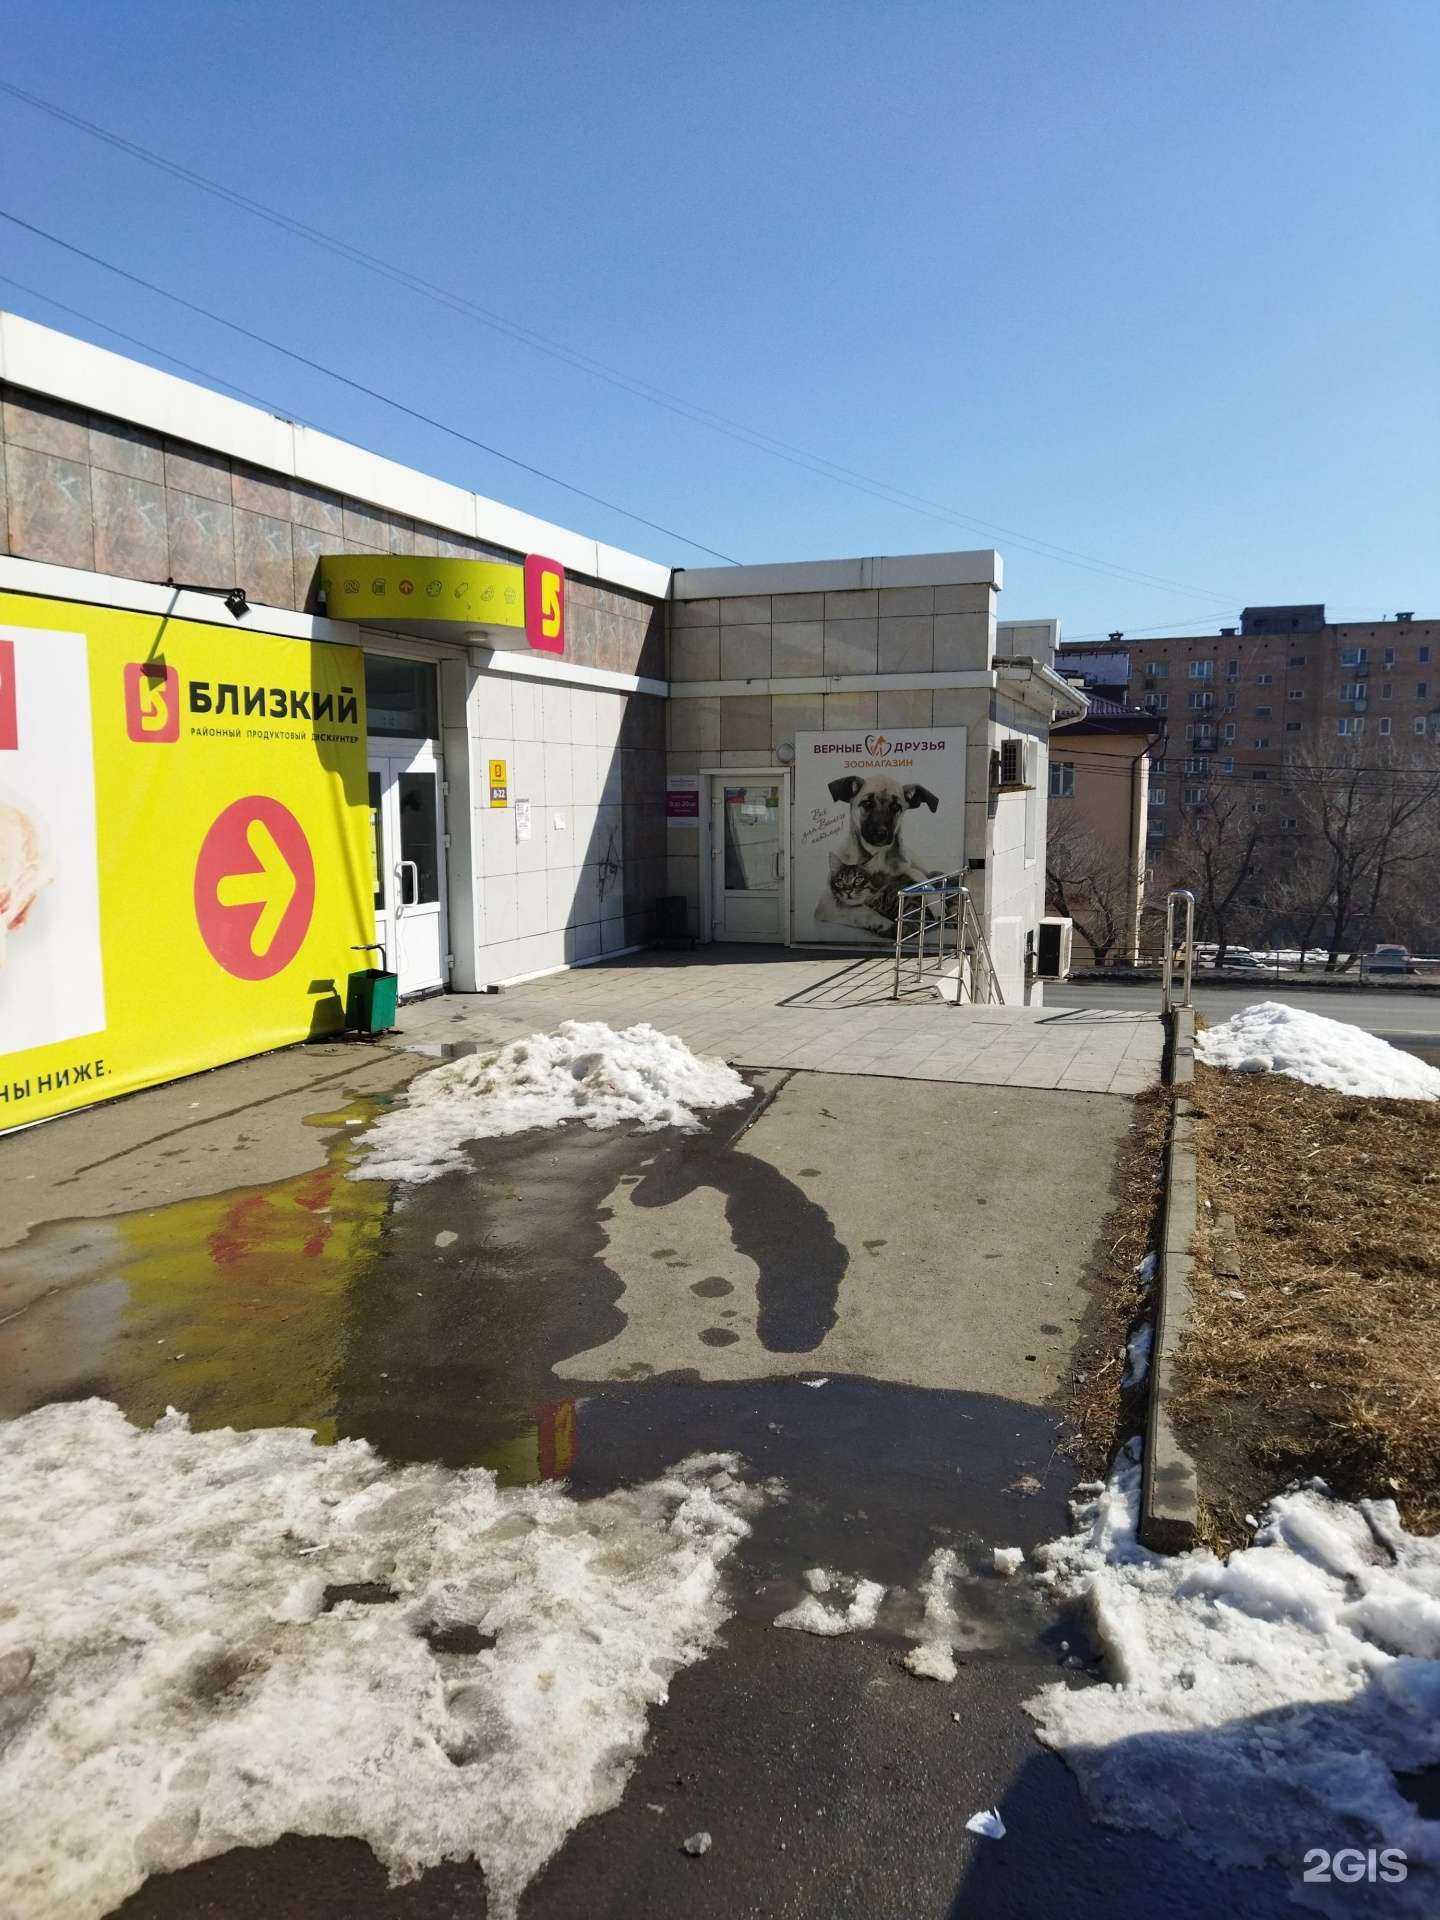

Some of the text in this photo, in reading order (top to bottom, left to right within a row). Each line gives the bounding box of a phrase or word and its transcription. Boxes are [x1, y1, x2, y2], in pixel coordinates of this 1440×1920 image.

[188, 681, 358, 724] БЛИЗКИЙ
[191, 727, 242, 738] РАЙОННЫЙ
[246, 728, 307, 741] ПРОДУКТОВЫЙ
[814, 740, 945, 754] ВЕРНЫЕ ДРУЗЬЯ
[844, 759, 913, 769] ЗООМАГАЗИН
[37, 1059, 112, 1093] НИЖЕ.
